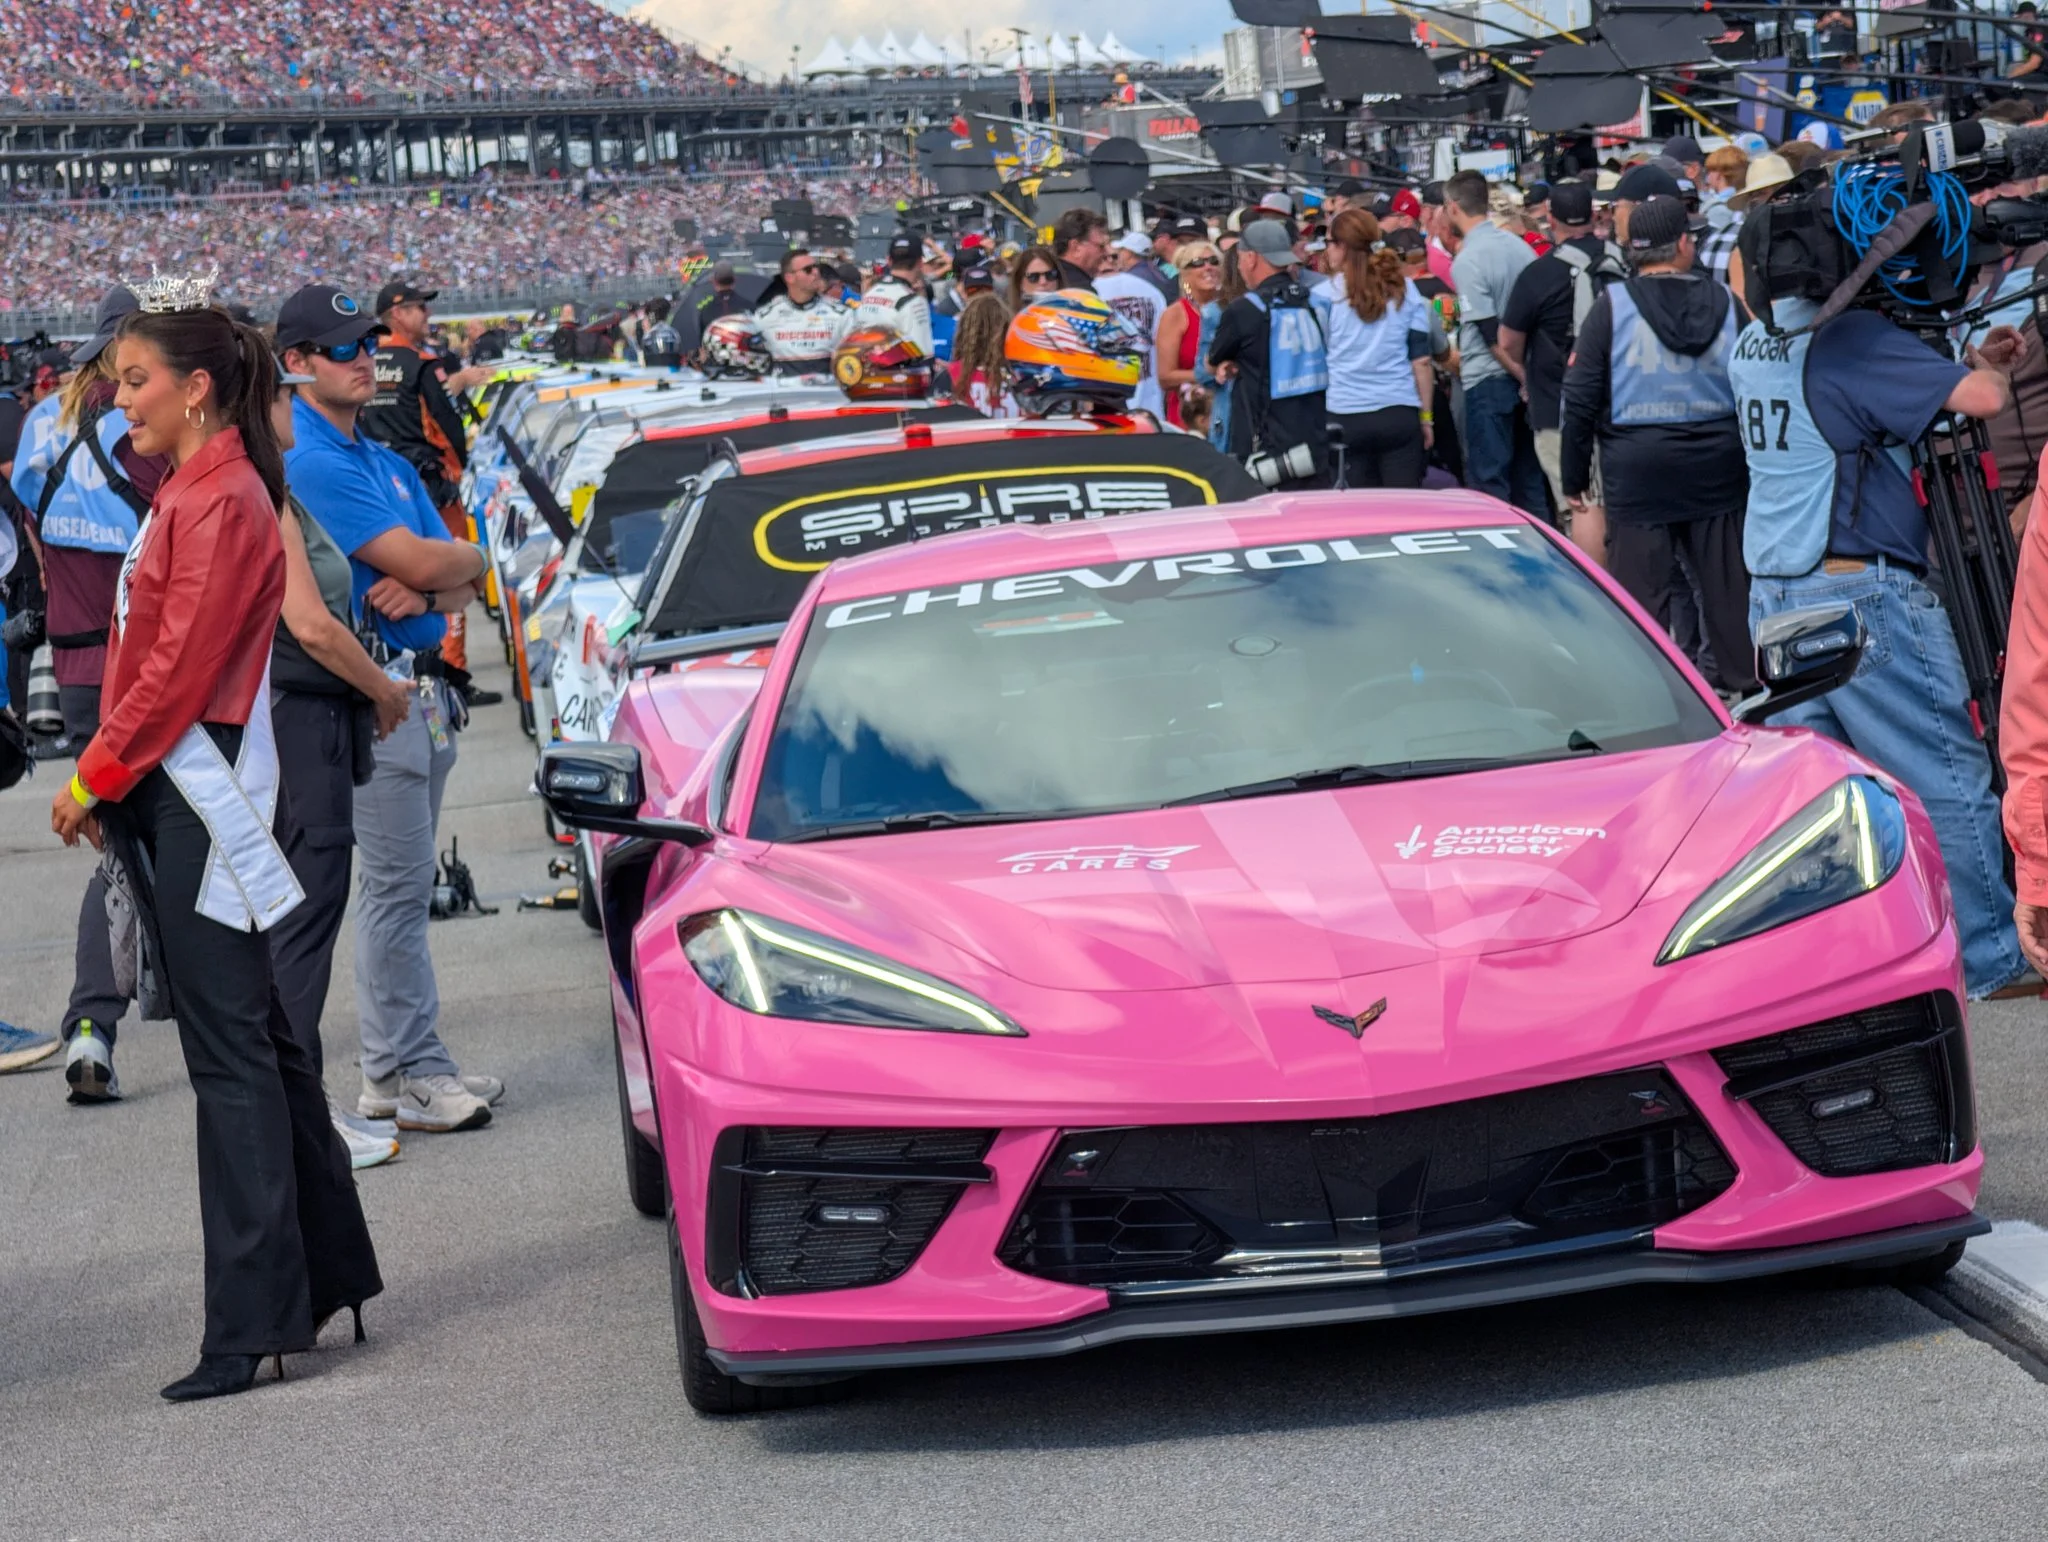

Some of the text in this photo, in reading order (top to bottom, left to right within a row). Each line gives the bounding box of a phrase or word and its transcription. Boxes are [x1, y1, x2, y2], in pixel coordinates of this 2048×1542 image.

[1734, 331, 1795, 363] Kodak
[801, 482, 1171, 541] SPIRE
[825, 528, 1521, 628] CHEVROLET
[1437, 824, 1607, 839] American
[1433, 835, 1563, 846] Cancer
[1431, 844, 1563, 857] Society
[1010, 857, 1172, 874] CARES
